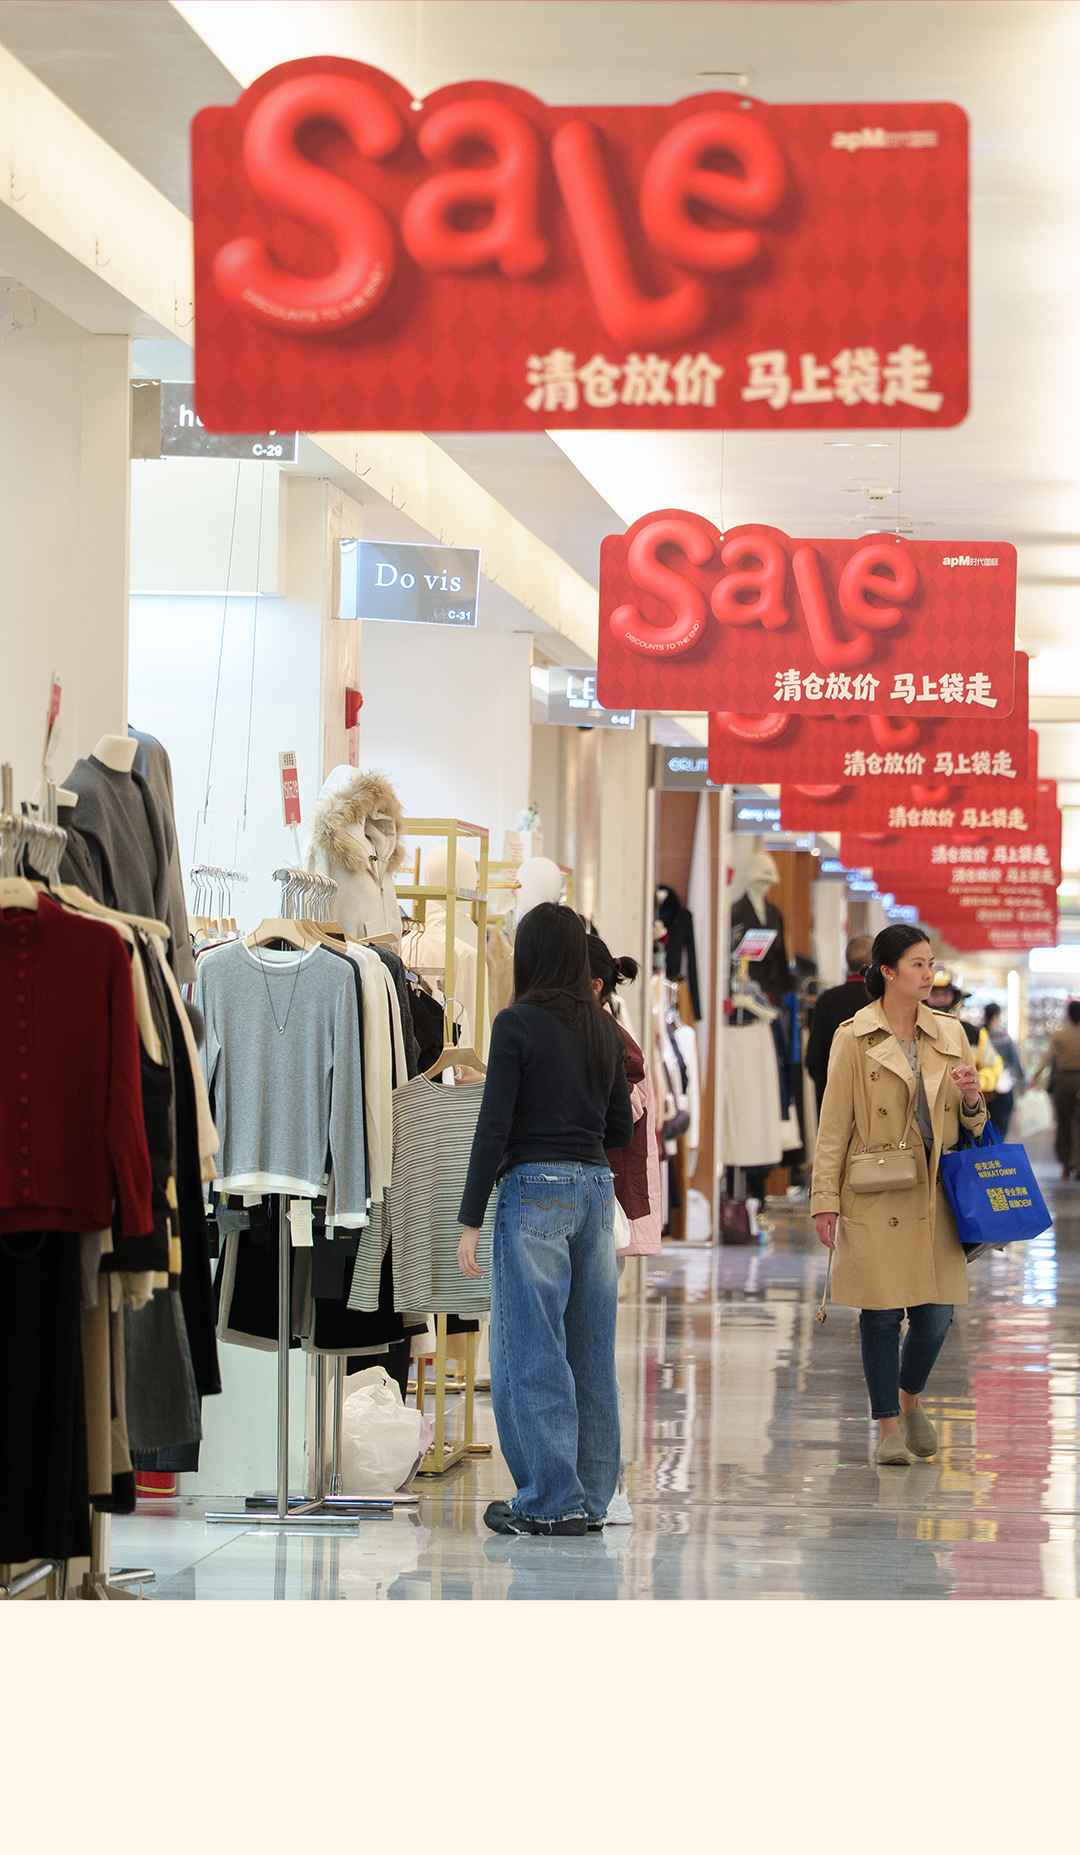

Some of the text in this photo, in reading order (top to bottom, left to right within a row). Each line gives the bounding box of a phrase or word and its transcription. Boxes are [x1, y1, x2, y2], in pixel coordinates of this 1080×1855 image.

[213, 73, 787, 345] Sale
[525, 344, 943, 412] 清仓放价 马上袋走
[252, 443, 283, 457] C-29
[375, 563, 462, 592] Do vis
[610, 519, 918, 671] Sale
[447, 609, 471, 620] C-31
[625, 632, 664, 650] DISCOUNTS
[676, 636, 690, 647] THE
[773, 669, 998, 708] 清仓放价 马上袋走
[844, 750, 1017, 780] 清仓放价 马上袋走
[888, 805, 1029, 832] 清仓放价 马上袋走
